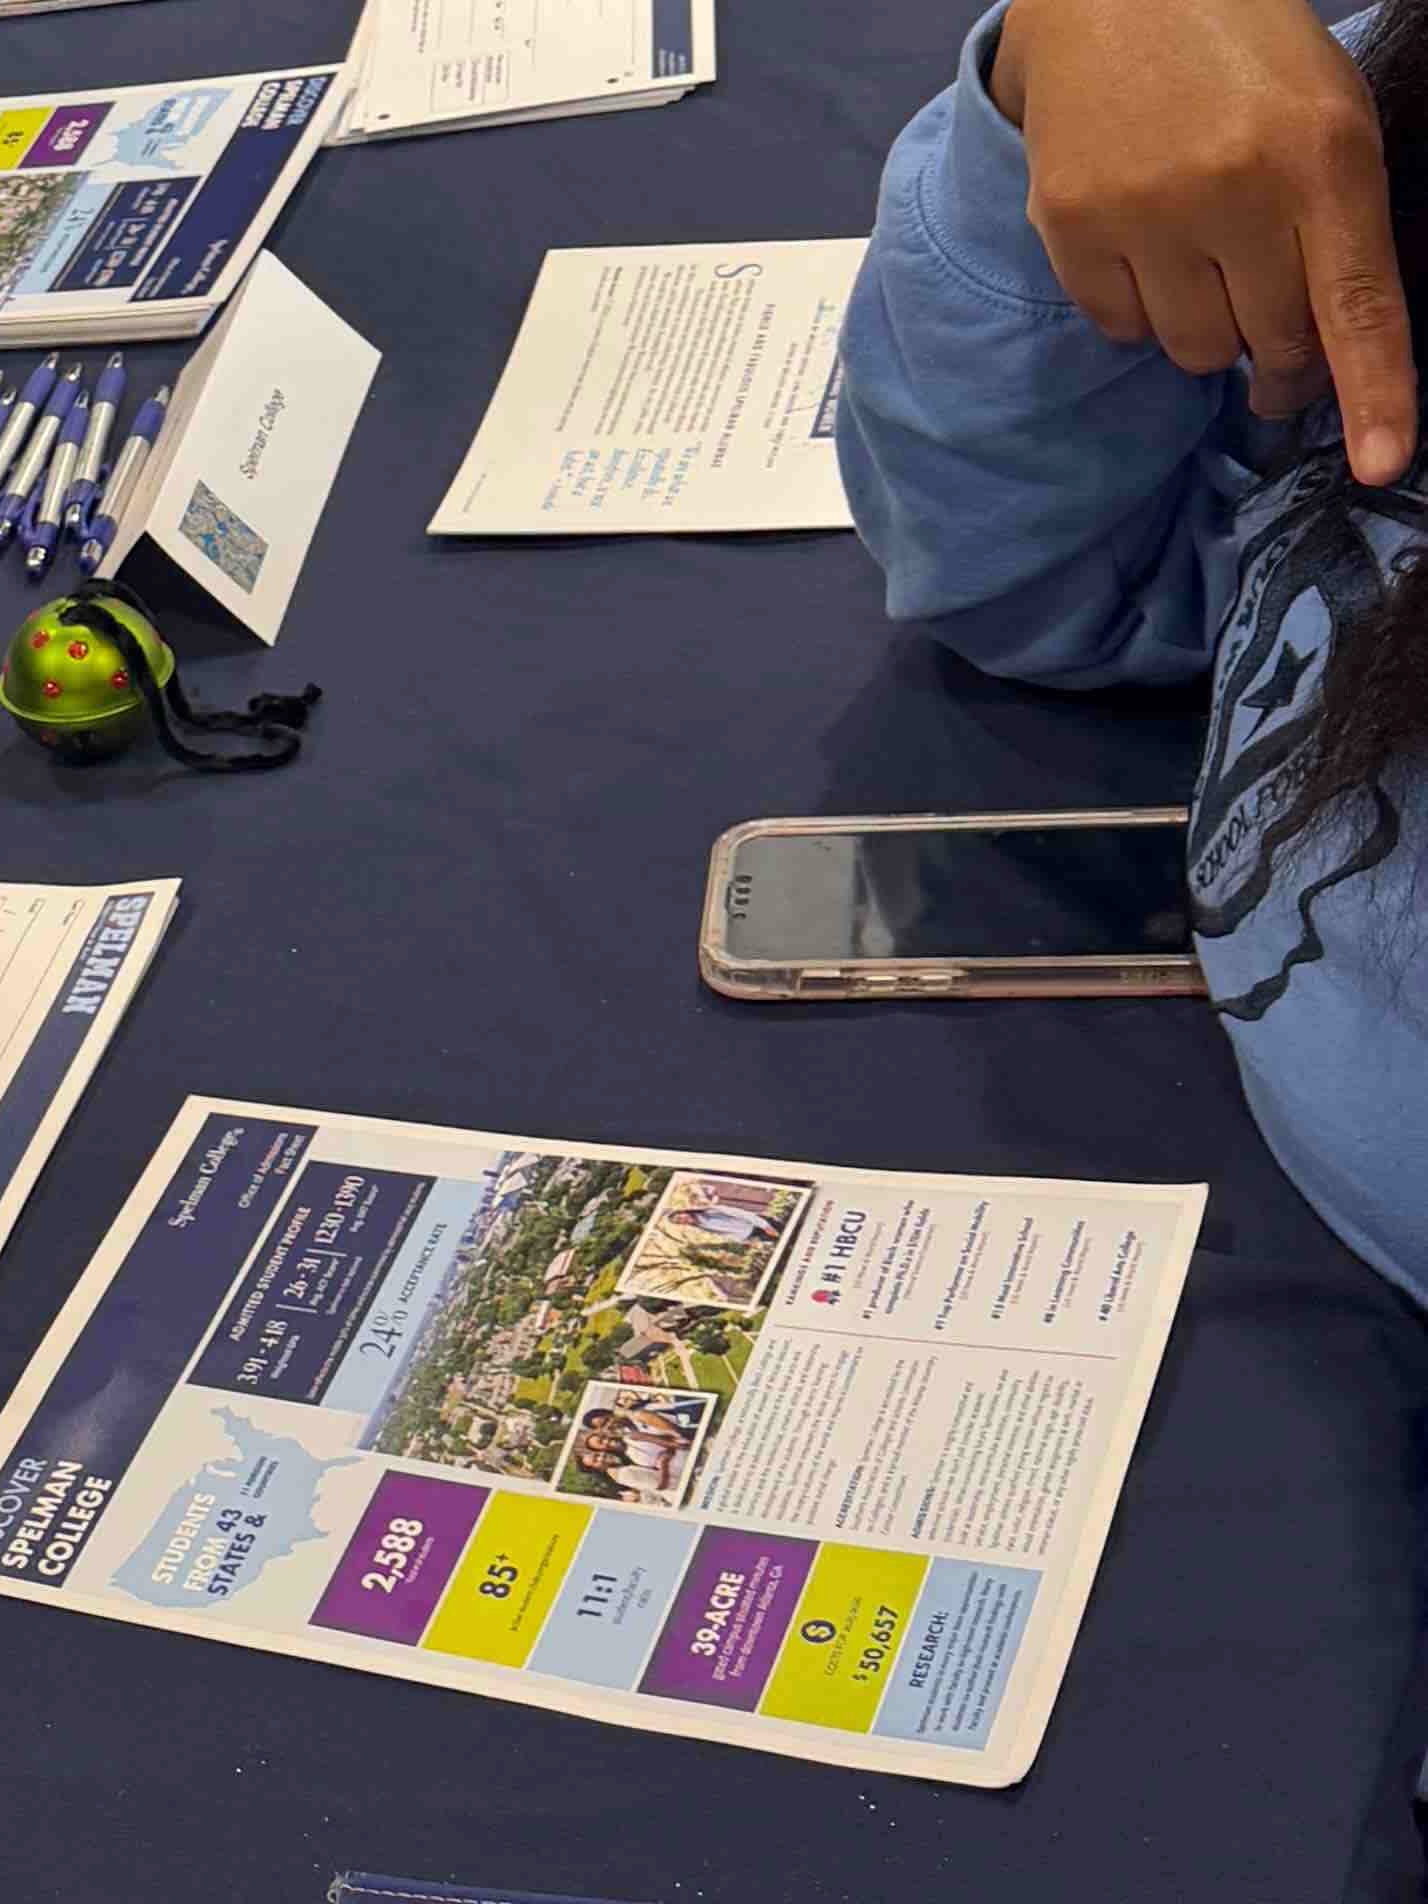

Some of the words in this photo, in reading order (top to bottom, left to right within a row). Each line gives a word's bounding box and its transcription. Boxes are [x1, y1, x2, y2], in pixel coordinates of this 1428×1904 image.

[62, 896, 147, 1013] SPELMAN
[167, 1176, 211, 1227] Spelman
[829, 1210, 866, 1257] HBCU
[229, 1291, 264, 1340] ADMITTED
[256, 1245, 288, 1289] STUDENT
[280, 1207, 310, 1244] PROFILE
[282, 1280, 308, 1298] 26
[296, 1257, 320, 1272] 31
[359, 1310, 408, 1358] 24%
[397, 1246, 435, 1303] ACCEPTANCE
[427, 1223, 447, 1244] RATE
[821, 1264, 845, 1283] #1
[1, 1460, 82, 1568] SPELMAN
[37, 1476, 112, 1575] COLLEGE
[151, 1493, 215, 1584] STUDENTS
[182, 1537, 229, 1591] FROM
[215, 1508, 242, 1532] 43
[207, 1532, 255, 1595] STATES
[243, 1514, 266, 1527] &
[361, 1518, 422, 1592] 2,588
[479, 1554, 517, 1599] 85+
[576, 1573, 616, 1616] 11:1
[690, 1572, 744, 1655] 39-ACRE
[908, 1611, 948, 1688] RESEARCH:
